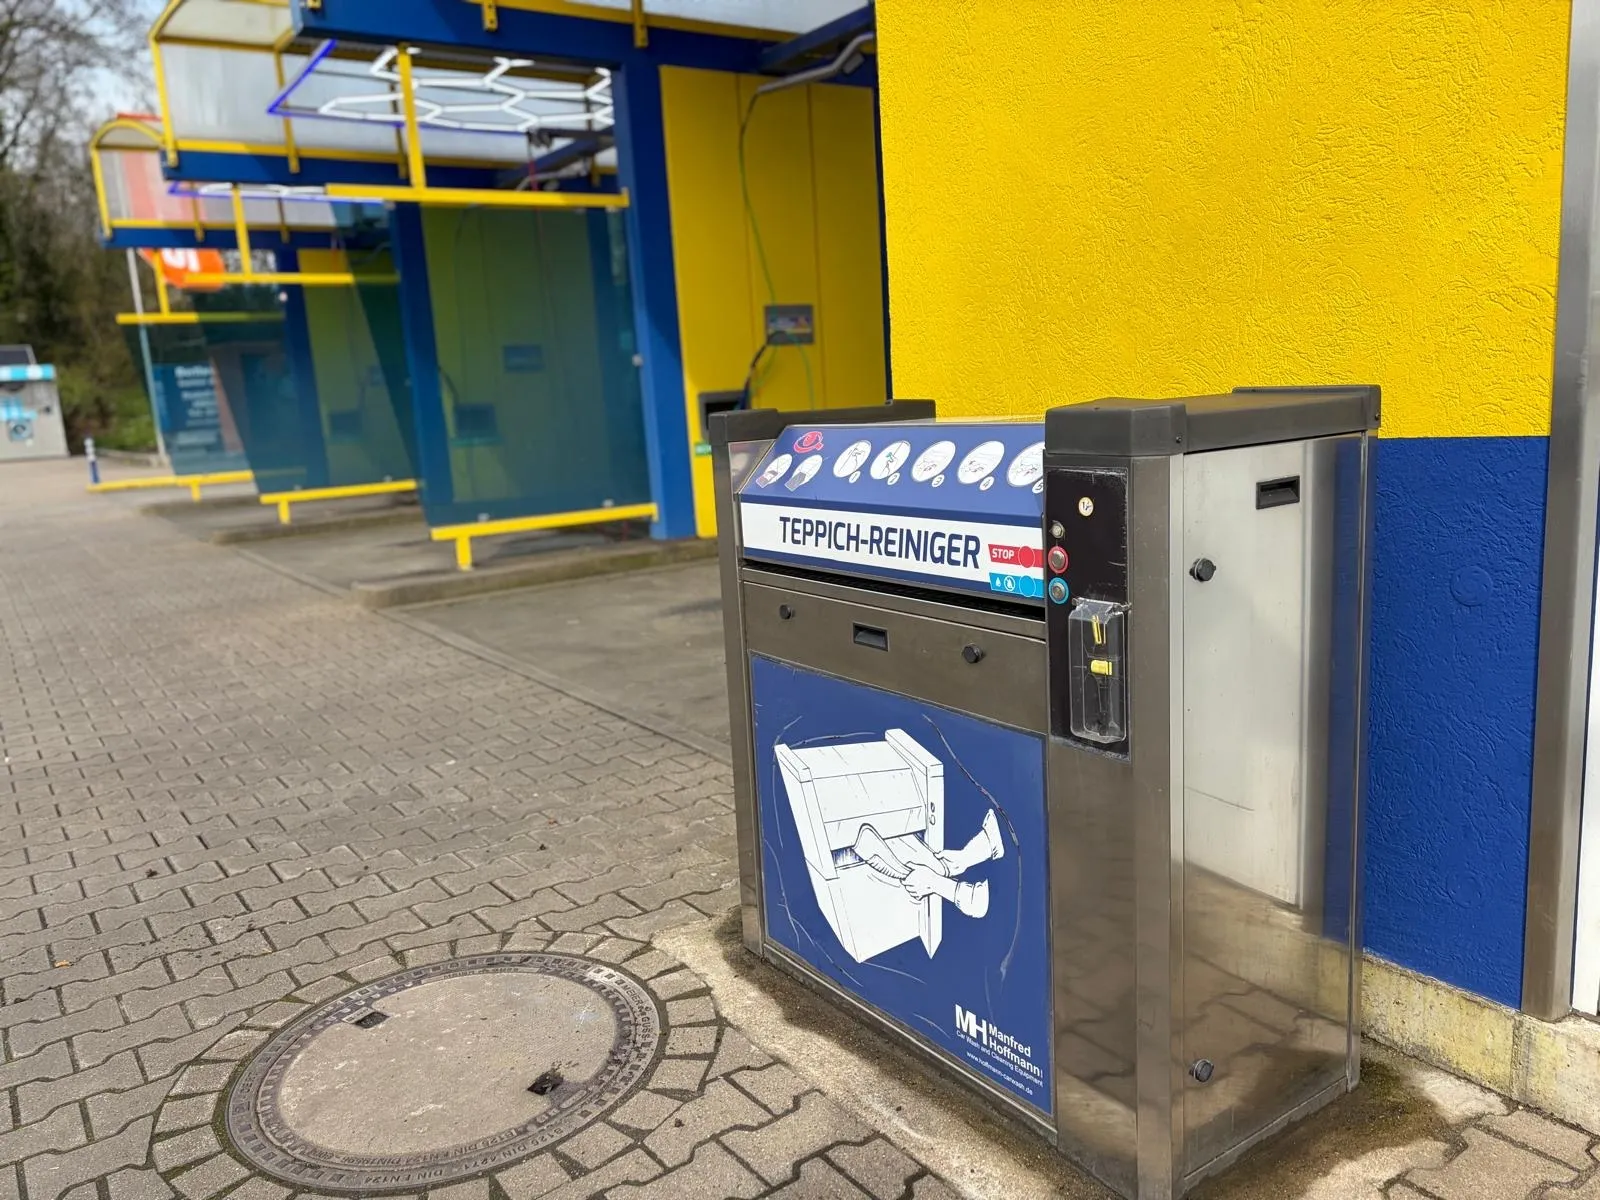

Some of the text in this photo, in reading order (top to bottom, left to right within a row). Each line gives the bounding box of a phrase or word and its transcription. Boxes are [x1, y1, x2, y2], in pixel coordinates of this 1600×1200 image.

[779, 516, 981, 569] TEPPICH-REINIGER
[991, 548, 1015, 560] STOP
[955, 1004, 988, 1046] MH
[989, 1023, 1031, 1058] Manfred
[956, 1029, 1044, 1088] Car Wash and Cleaning Equipment
[966, 1051, 1033, 1096] www.hoffmann-carwash.de
[989, 1037, 1040, 1077] Hoffmann
[502, 1145, 527, 1158] DIN
